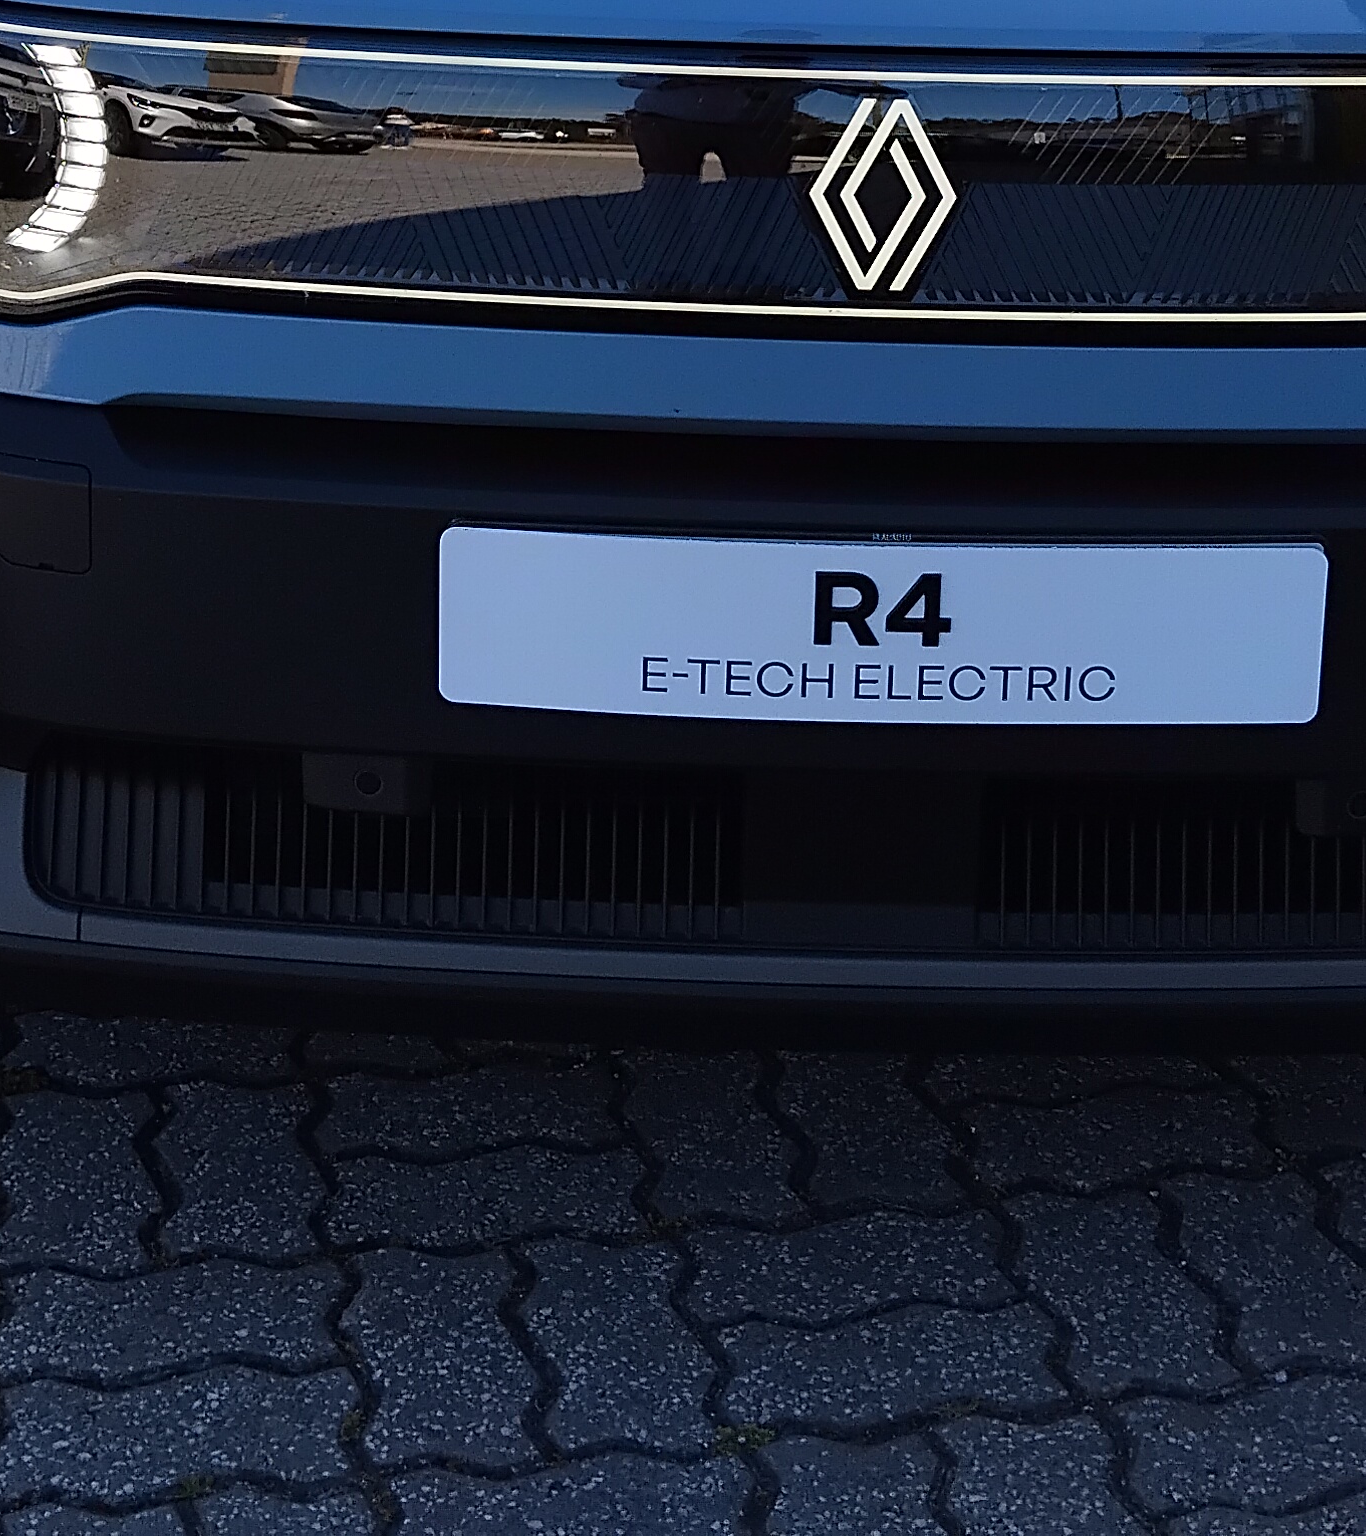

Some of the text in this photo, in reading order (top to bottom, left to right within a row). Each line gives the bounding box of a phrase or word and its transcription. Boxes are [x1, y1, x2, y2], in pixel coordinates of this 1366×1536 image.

[812, 569, 952, 648] R4
[641, 656, 1117, 703] E-TECH ELECTRIC
